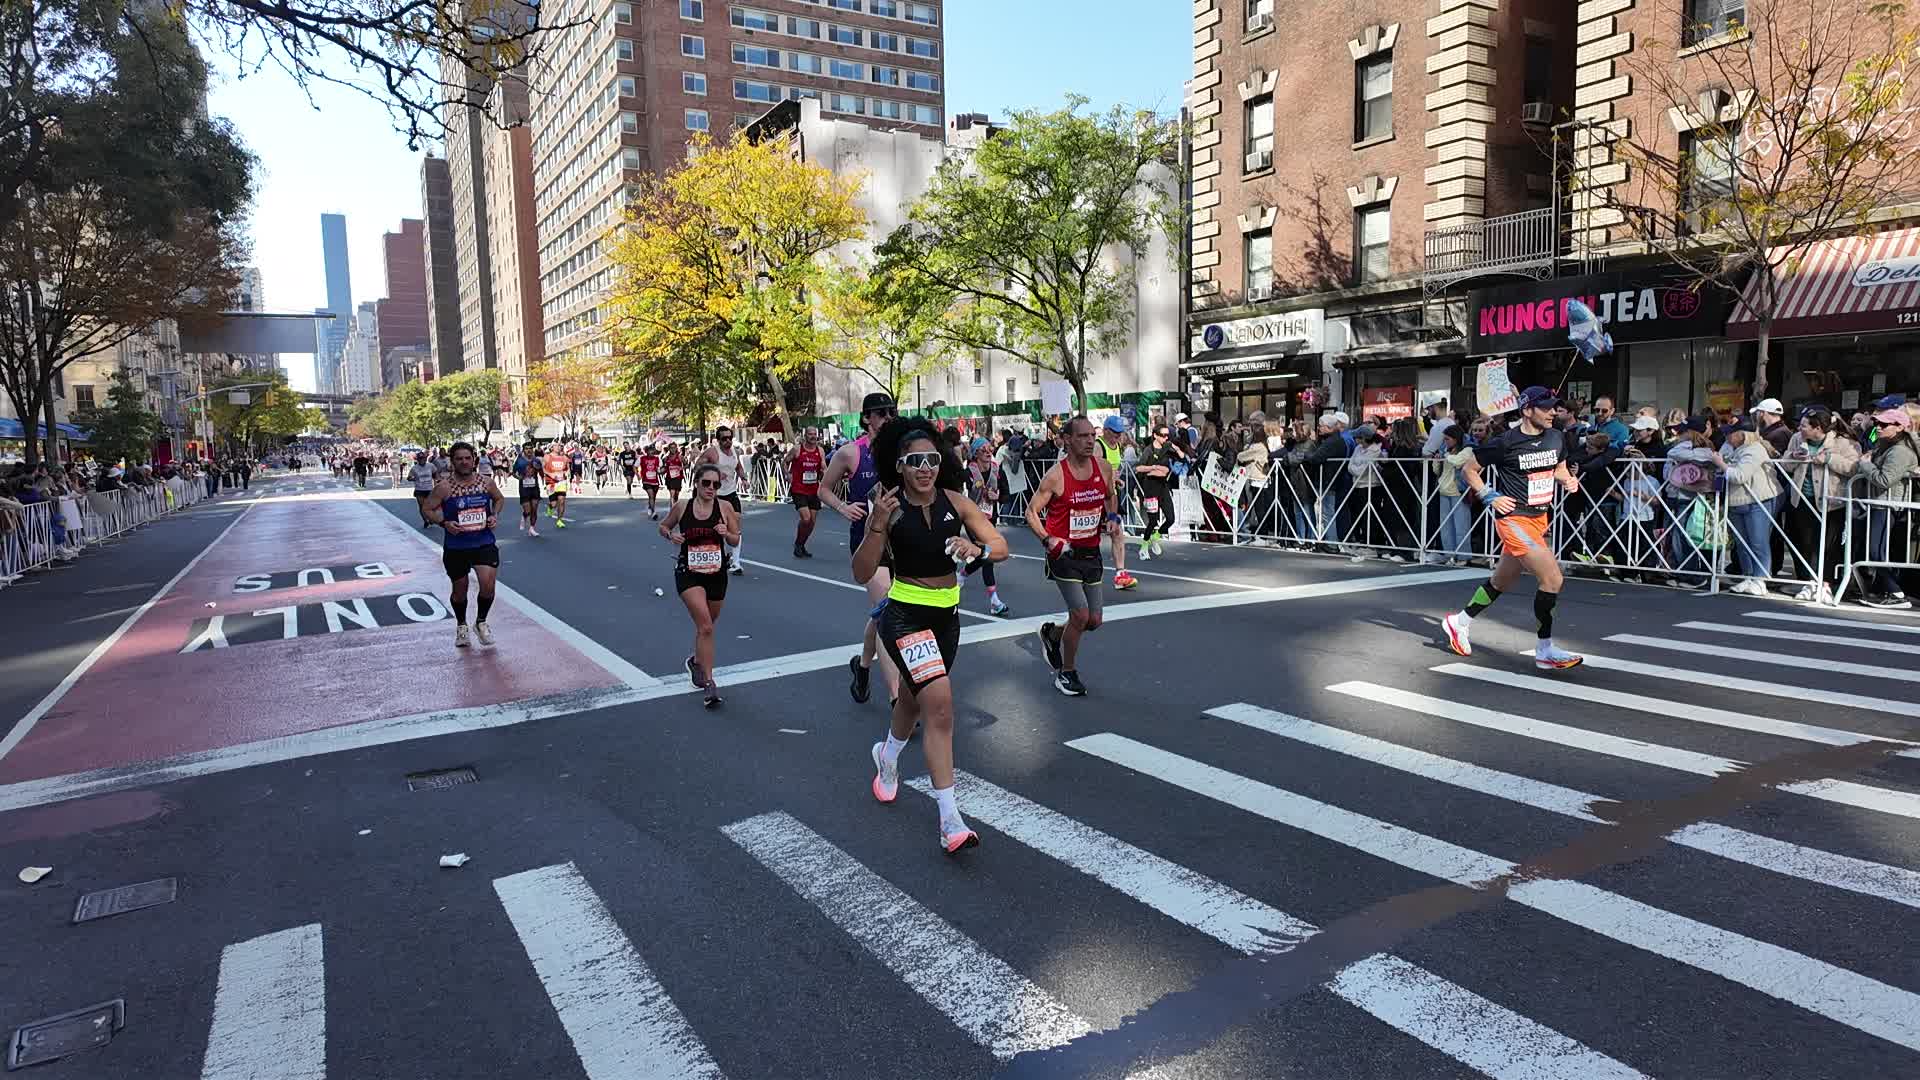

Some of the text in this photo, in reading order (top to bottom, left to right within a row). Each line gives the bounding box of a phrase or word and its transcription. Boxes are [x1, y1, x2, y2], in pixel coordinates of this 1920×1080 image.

[1479, 300, 1554, 336] KUNG
[1600, 288, 1658, 323] TEA
[1897, 312, 1920, 324] 121
[1518, 449, 1557, 462] MIDNIGHT
[1520, 456, 1558, 470] RUNNERS
[461, 513, 484, 522] 29701
[690, 552, 720, 562] 35955
[232, 561, 395, 593] BUS
[177, 593, 448, 655] ONLY
